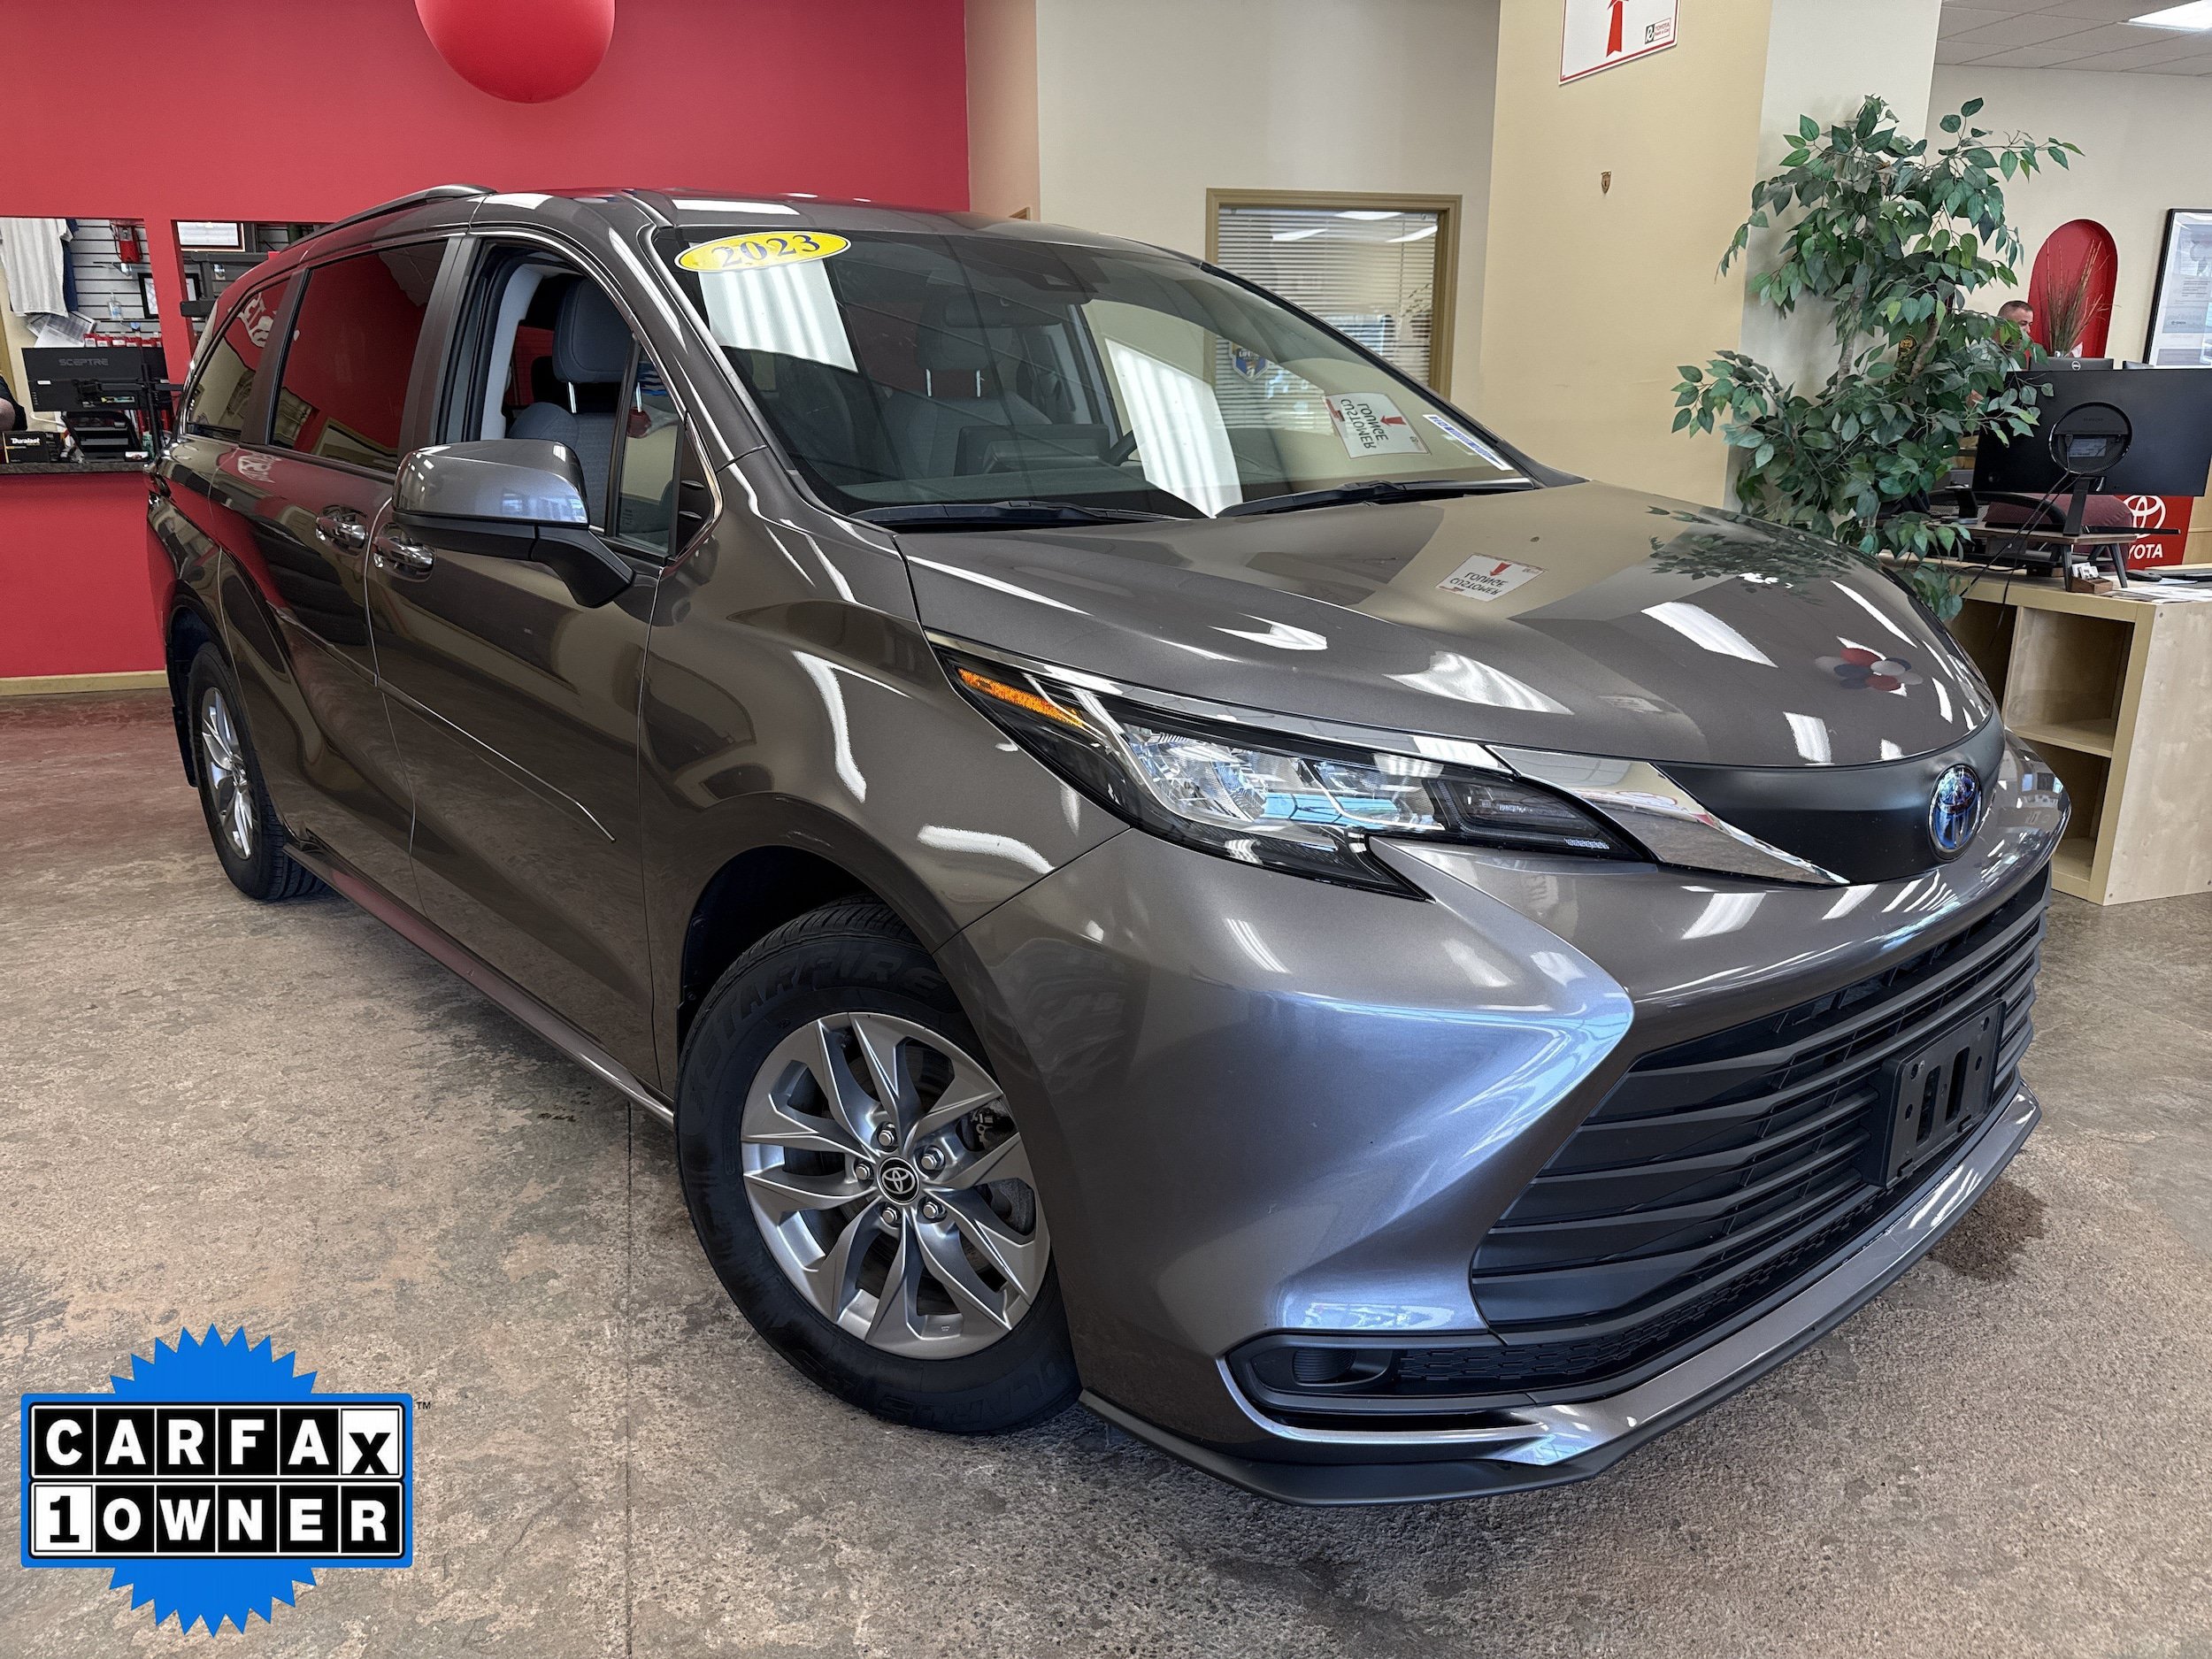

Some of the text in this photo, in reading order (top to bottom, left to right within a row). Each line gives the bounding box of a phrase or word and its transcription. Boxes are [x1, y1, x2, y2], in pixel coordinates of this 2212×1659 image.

[711, 234, 820, 268] 2023
[58, 357, 109, 366] SCEPTRE
[2128, 543, 2163, 559] YOTA
